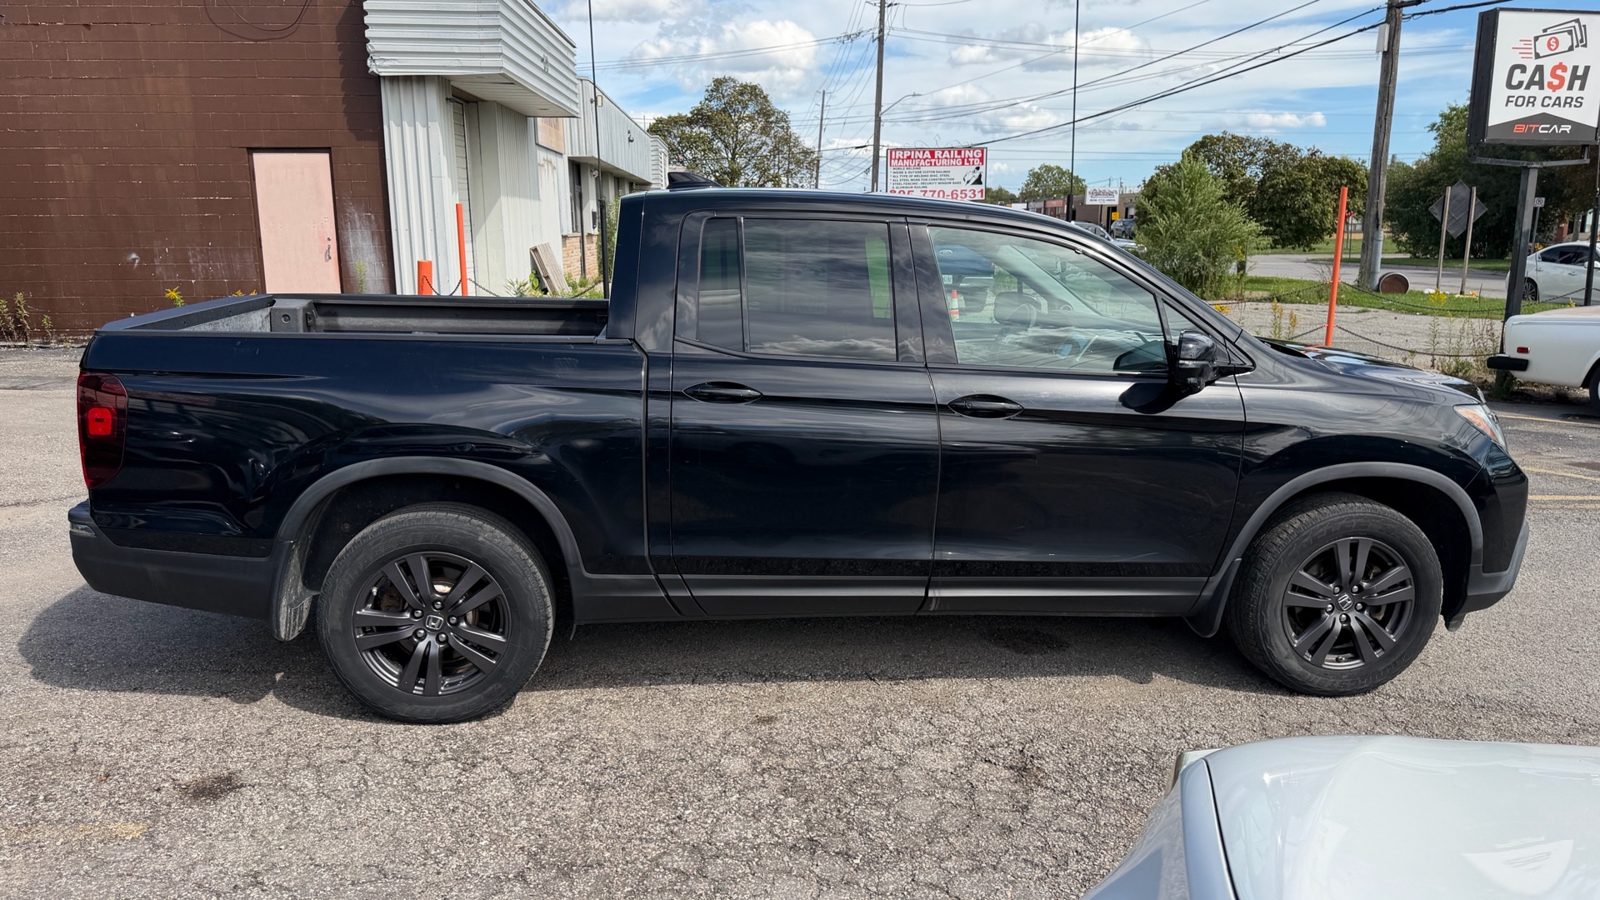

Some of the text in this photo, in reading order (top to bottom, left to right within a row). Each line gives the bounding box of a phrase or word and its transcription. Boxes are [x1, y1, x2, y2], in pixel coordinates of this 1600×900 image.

[1505, 95, 1584, 108] FOR CARS
[1513, 123, 1572, 134] BITCAR
[892, 149, 982, 159] IRPINA RAILING
